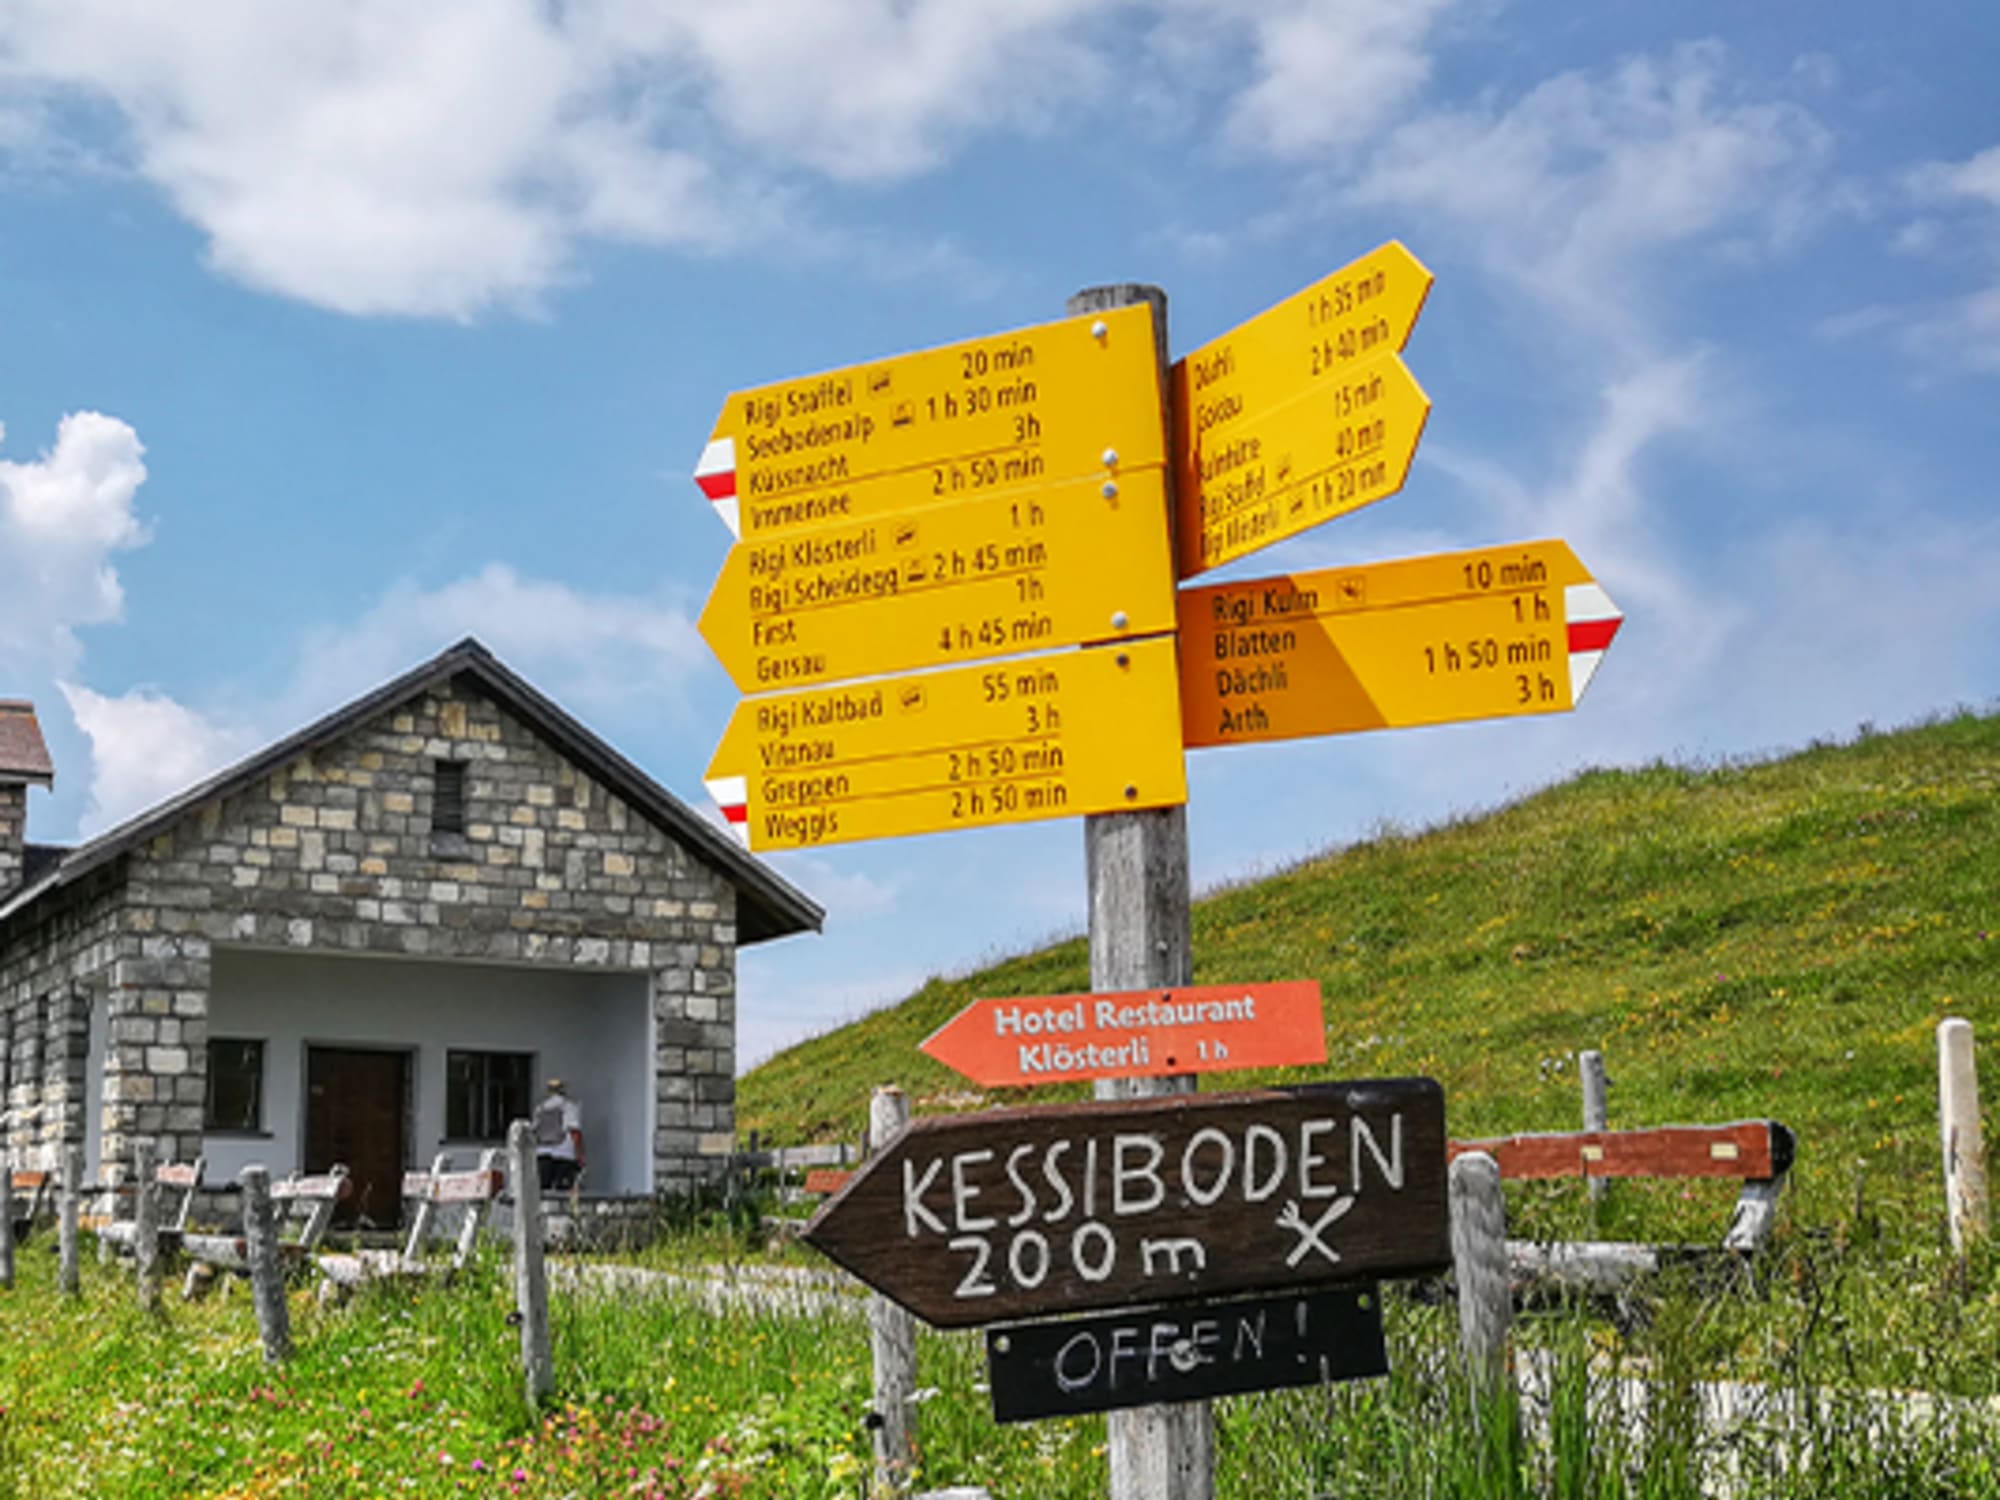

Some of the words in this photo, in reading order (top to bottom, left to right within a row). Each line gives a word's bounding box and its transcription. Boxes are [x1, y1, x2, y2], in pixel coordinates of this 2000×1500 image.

[962, 350, 988, 380] 20
[994, 343, 1034, 371] min
[745, 392, 781, 427] Rigi
[786, 380, 853, 417] Staffel
[944, 390, 958, 418] h
[966, 385, 991, 413] 30
[997, 377, 1037, 405] min
[746, 412, 875, 462] Seebodenalp
[932, 468, 944, 495] 2
[952, 462, 965, 491] h
[971, 457, 997, 486] 50
[1004, 448, 1044, 478] min
[750, 491, 851, 530] Immensee
[1029, 499, 1044, 527] h
[749, 545, 786, 580] Rigi
[792, 528, 877, 568] Klösterli
[932, 553, 946, 581] 2
[952, 546, 965, 575] h
[971, 542, 999, 571] 45
[1005, 536, 1047, 565] min
[1463, 560, 1493, 591] 10
[1501, 553, 1547, 585] min
[750, 580, 789, 614] Rigi
[794, 563, 899, 605] Scheidegg
[1212, 591, 1256, 625] Rigi
[1533, 592, 1550, 621] h
[753, 618, 797, 647] First
[938, 625, 951, 652] 4
[959, 620, 973, 650] h
[978, 616, 1006, 646] 45
[1012, 610, 1052, 640] min
[1214, 627, 1296, 660] Blatten
[756, 652, 826, 683] Gersau
[1444, 643, 1461, 673] h
[1467, 639, 1498, 670] 50
[1507, 634, 1552, 665] min
[982, 674, 1009, 702] 55
[1016, 667, 1059, 697] min
[757, 701, 797, 736] Rigi
[802, 690, 883, 727] Kaltbad
[1026, 704, 1040, 733] 3
[1045, 701, 1060, 730] h
[1218, 703, 1269, 735] Arth
[948, 753, 961, 781] 2
[967, 748, 981, 778] h
[989, 745, 1018, 775] 50
[1023, 739, 1064, 770] min
[762, 773, 850, 806] Greppen
[951, 791, 963, 819] 2
[971, 786, 985, 816] h
[993, 783, 1021, 813] 50
[1026, 777, 1067, 807] min
[764, 806, 839, 844] Weggis
[993, 1003, 1085, 1036] Hotel
[1094, 994, 1256, 1030] Restaurant
[1018, 1037, 1150, 1073] Klösterli
[1214, 1038, 1229, 1060] h
[903, 1112, 1405, 1239] KESSIBODEN
[948, 1221, 1116, 1299] 200
[1140, 1234, 1206, 1276] m
